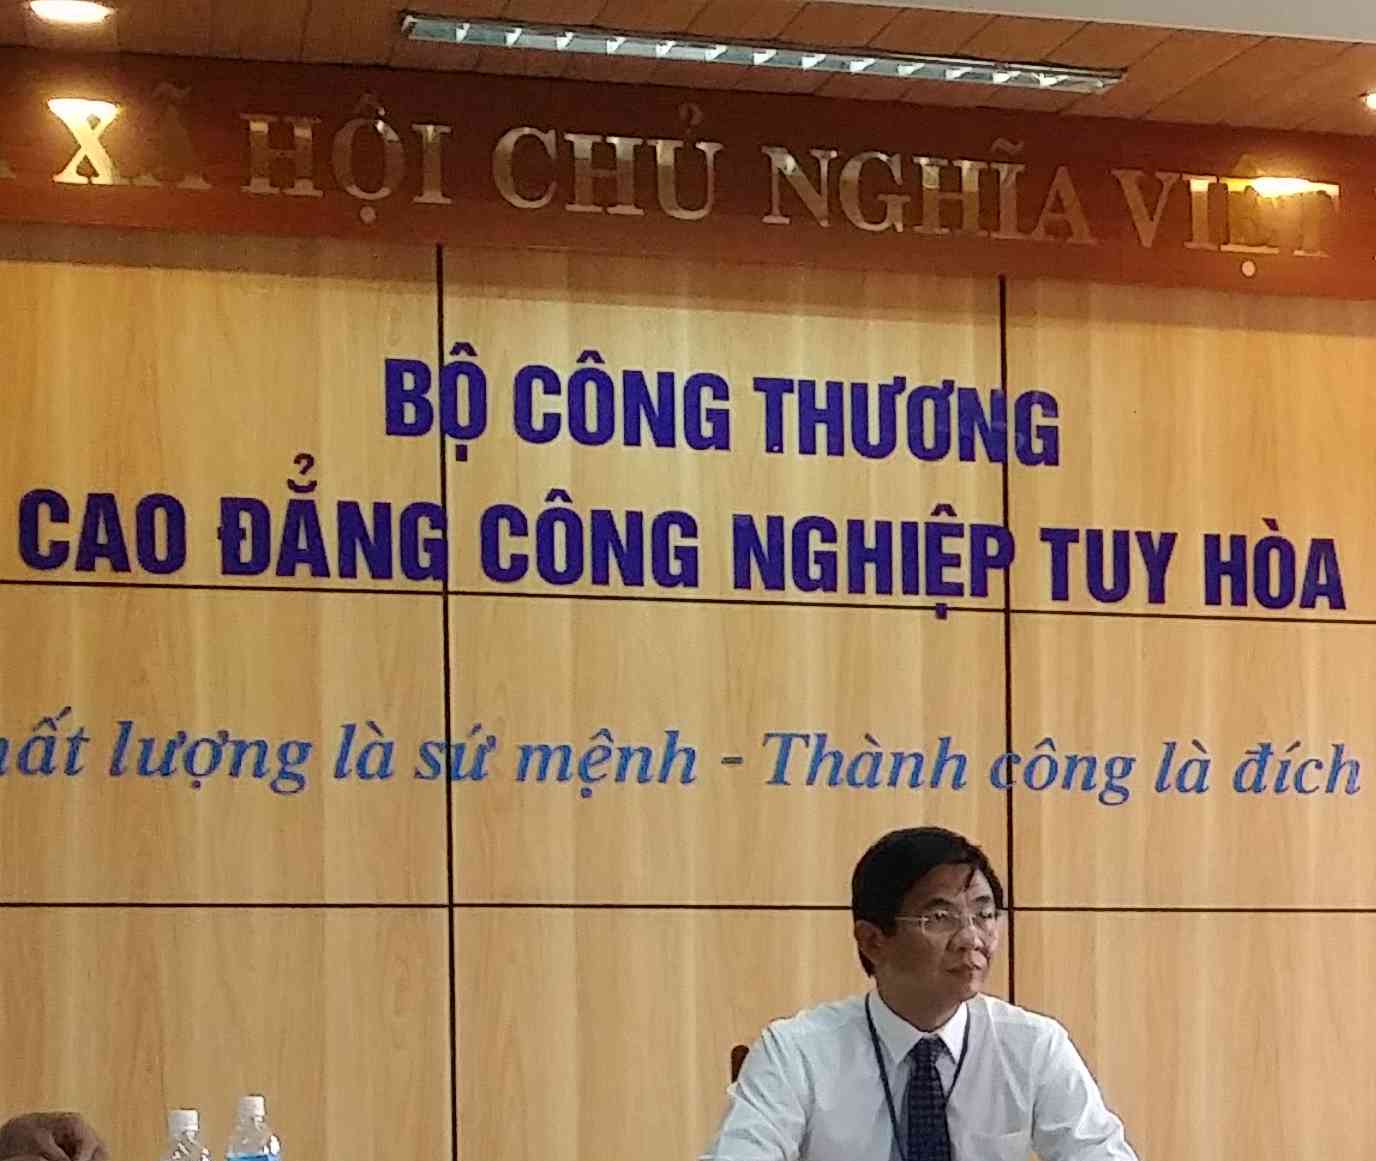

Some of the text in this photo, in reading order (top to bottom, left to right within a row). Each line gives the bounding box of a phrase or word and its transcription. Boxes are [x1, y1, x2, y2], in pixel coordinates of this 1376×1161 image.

[47, 82, 211, 190] XÃ
[240, 92, 452, 224] HỘI
[492, 103, 723, 220] CHỦ
[761, 138, 1097, 245] NGHĨA
[1112, 153, 1340, 278] VIỆT
[385, 342, 1059, 466] BỘ CÔNG THƯƠNG
[18, 452, 1346, 620] CAO ĐẲNG CÔNG NGHIỆP TUY HÒA
[109, 720, 313, 795] lượng
[333, 720, 394, 781] là
[414, 724, 497, 781] sứ
[515, 728, 696, 799] mệnh
[762, 731, 969, 790] Thành
[989, 740, 1137, 806] công
[1154, 740, 1211, 794] là
[1232, 741, 1361, 795] đích
